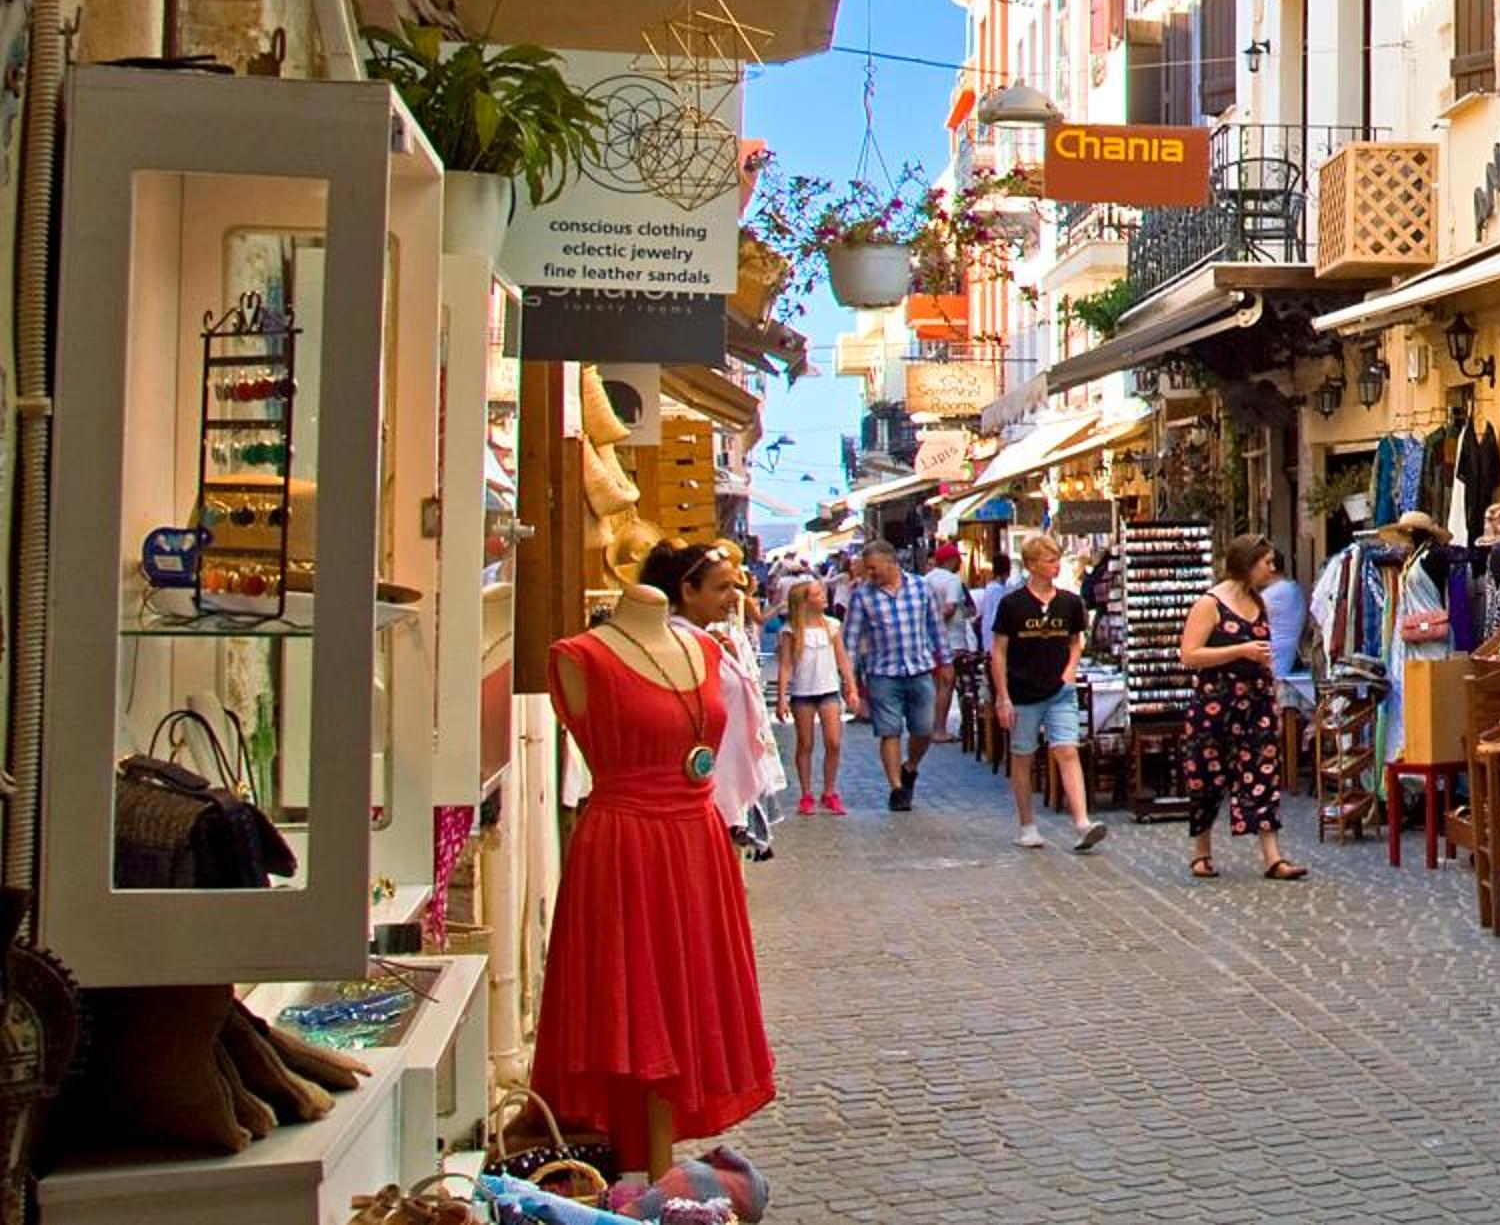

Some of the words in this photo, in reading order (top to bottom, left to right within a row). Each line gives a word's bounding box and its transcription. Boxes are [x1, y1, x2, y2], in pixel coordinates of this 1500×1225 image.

[1054, 129, 1184, 163] Chania
[549, 220, 633, 235] conscious
[637, 222, 707, 241] clothing
[562, 241, 626, 258] eclectic
[629, 244, 693, 263] jewelry
[543, 262, 576, 278] fine
[582, 265, 643, 281] leather
[647, 269, 711, 284] sandals
[1025, 618, 1063, 629] GUCI
